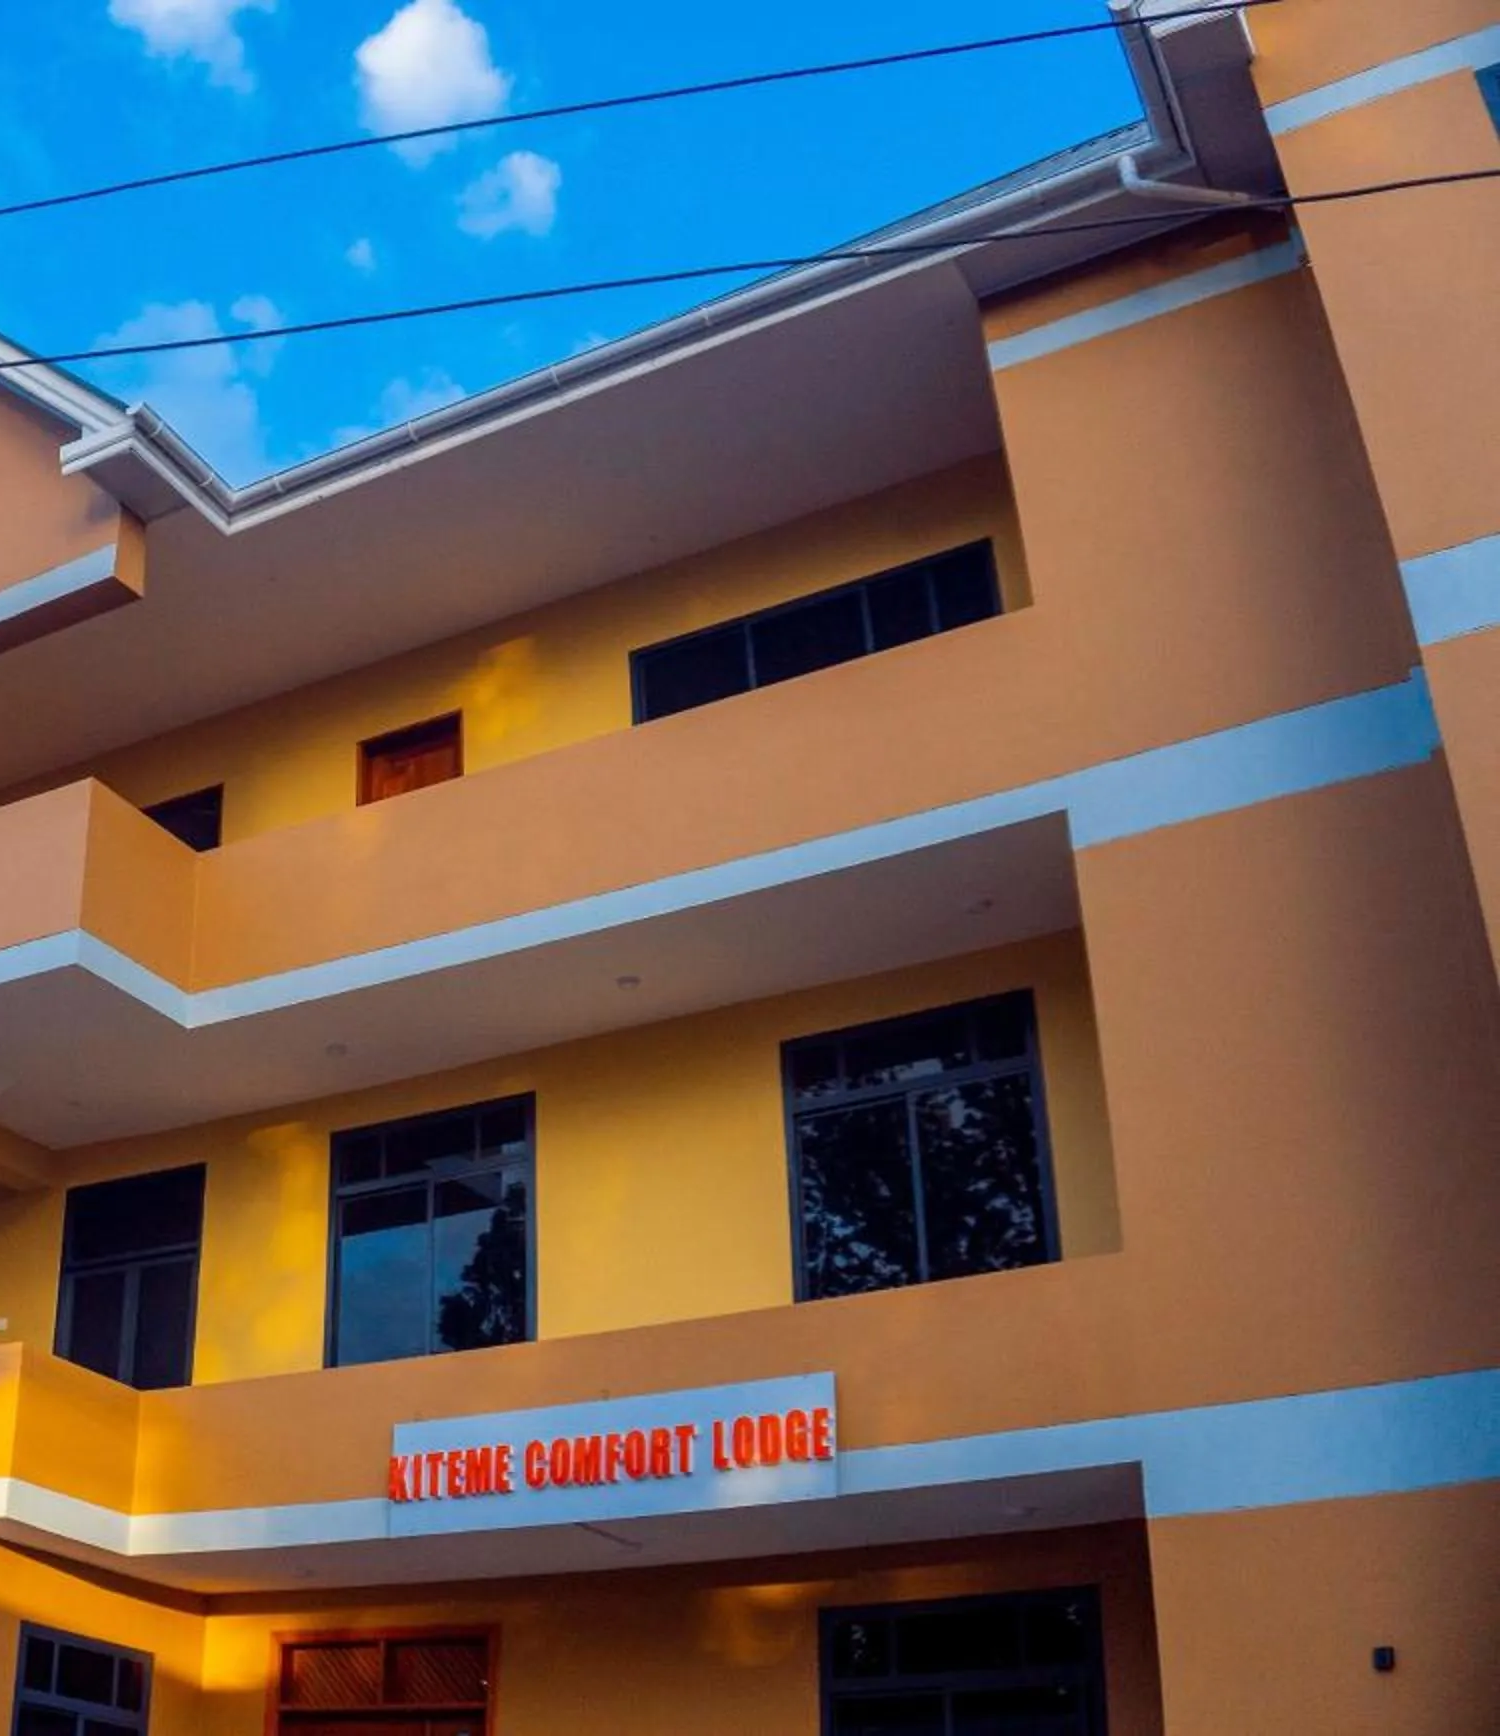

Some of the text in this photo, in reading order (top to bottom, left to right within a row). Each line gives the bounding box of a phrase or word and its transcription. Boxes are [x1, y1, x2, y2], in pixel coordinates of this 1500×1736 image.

[388, 1407, 834, 1502] KITEME COMFORT LODGE
